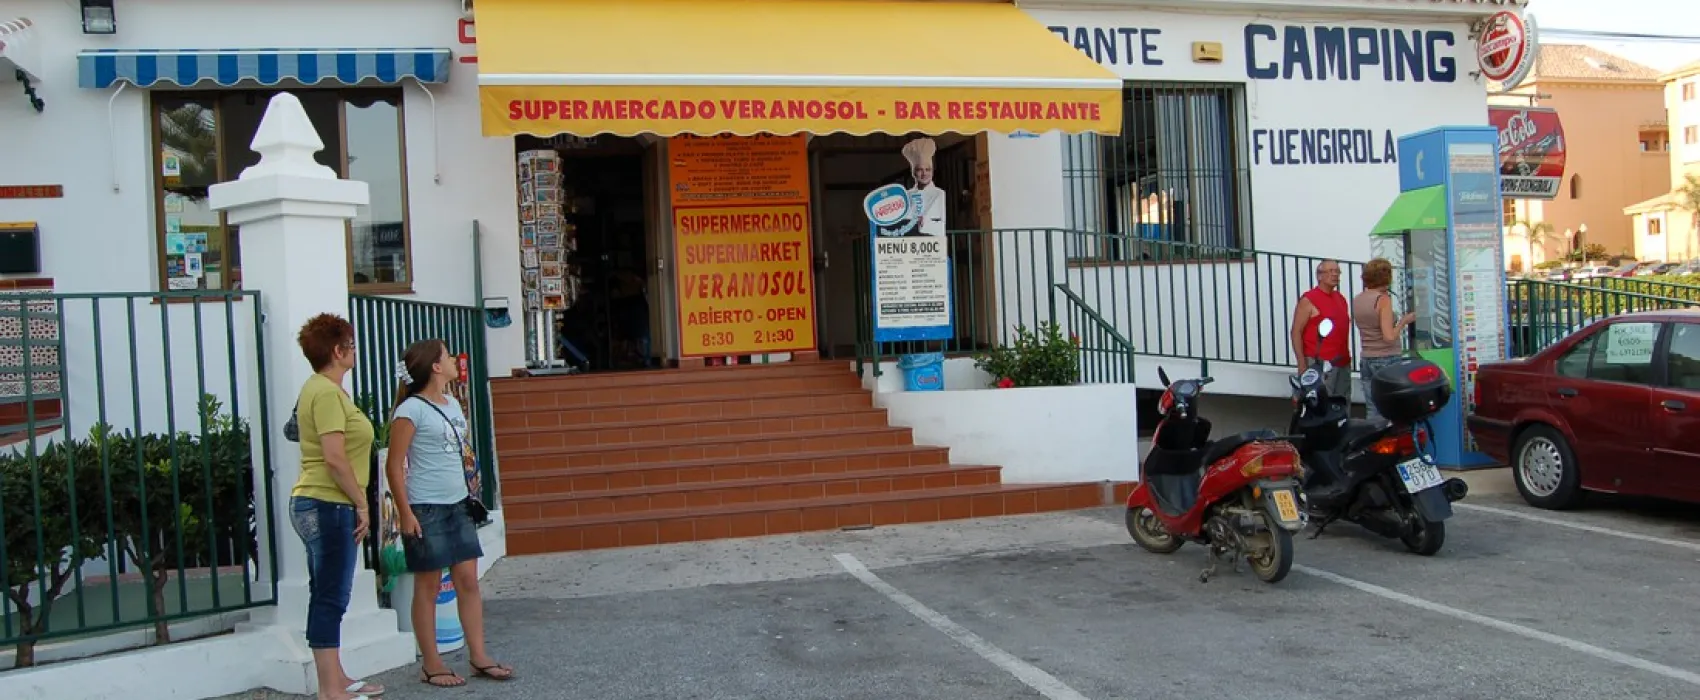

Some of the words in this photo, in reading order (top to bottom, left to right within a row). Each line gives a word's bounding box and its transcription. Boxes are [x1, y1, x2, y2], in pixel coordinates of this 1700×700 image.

[1244, 24, 1456, 82] CAMPING
[509, 99, 716, 120] SUPERMERCADO
[720, 100, 868, 120] VERANOSOL
[895, 101, 941, 120] BAR
[948, 101, 1100, 121] RESTAURANTE
[1252, 129, 1397, 165] FUENGIROLA
[681, 212, 803, 235] SUPERMERCADO
[685, 241, 802, 264] SUPERMARKET
[878, 238, 908, 255] MENÚ
[683, 270, 806, 300] VERANOSOL
[766, 306, 806, 322] OPEN
[702, 331, 735, 347] 8:30
[753, 328, 795, 344] 21:30
